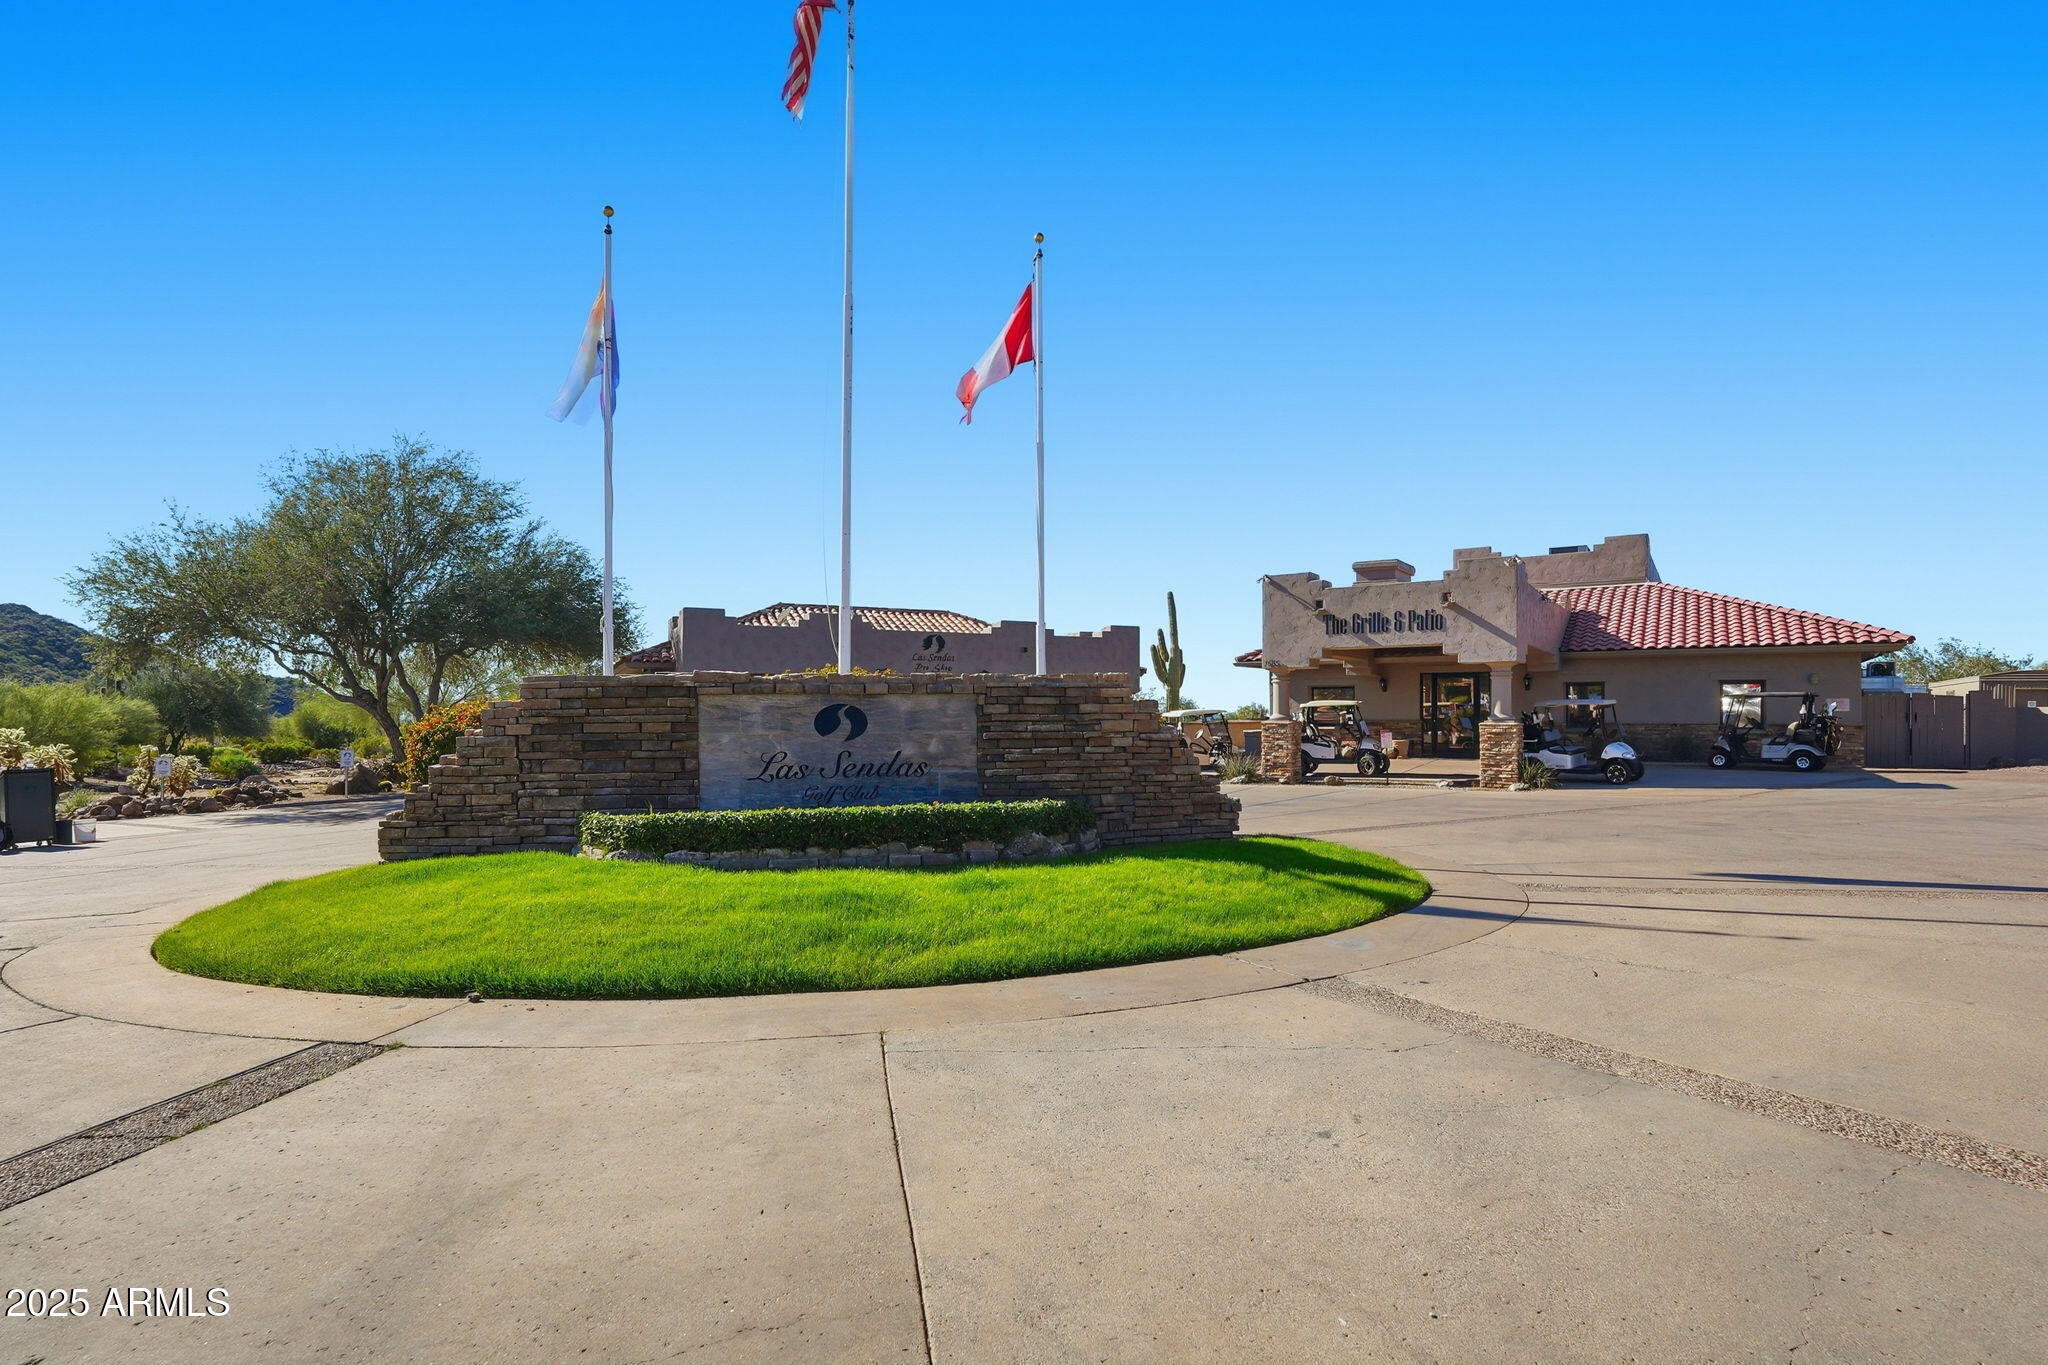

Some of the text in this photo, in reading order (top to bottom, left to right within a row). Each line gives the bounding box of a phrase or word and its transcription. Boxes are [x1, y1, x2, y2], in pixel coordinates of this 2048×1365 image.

[1322, 608, 1444, 635] The Grille & Patio
[747, 750, 930, 783] Las Sendas
[802, 785, 880, 805] Golf Club
